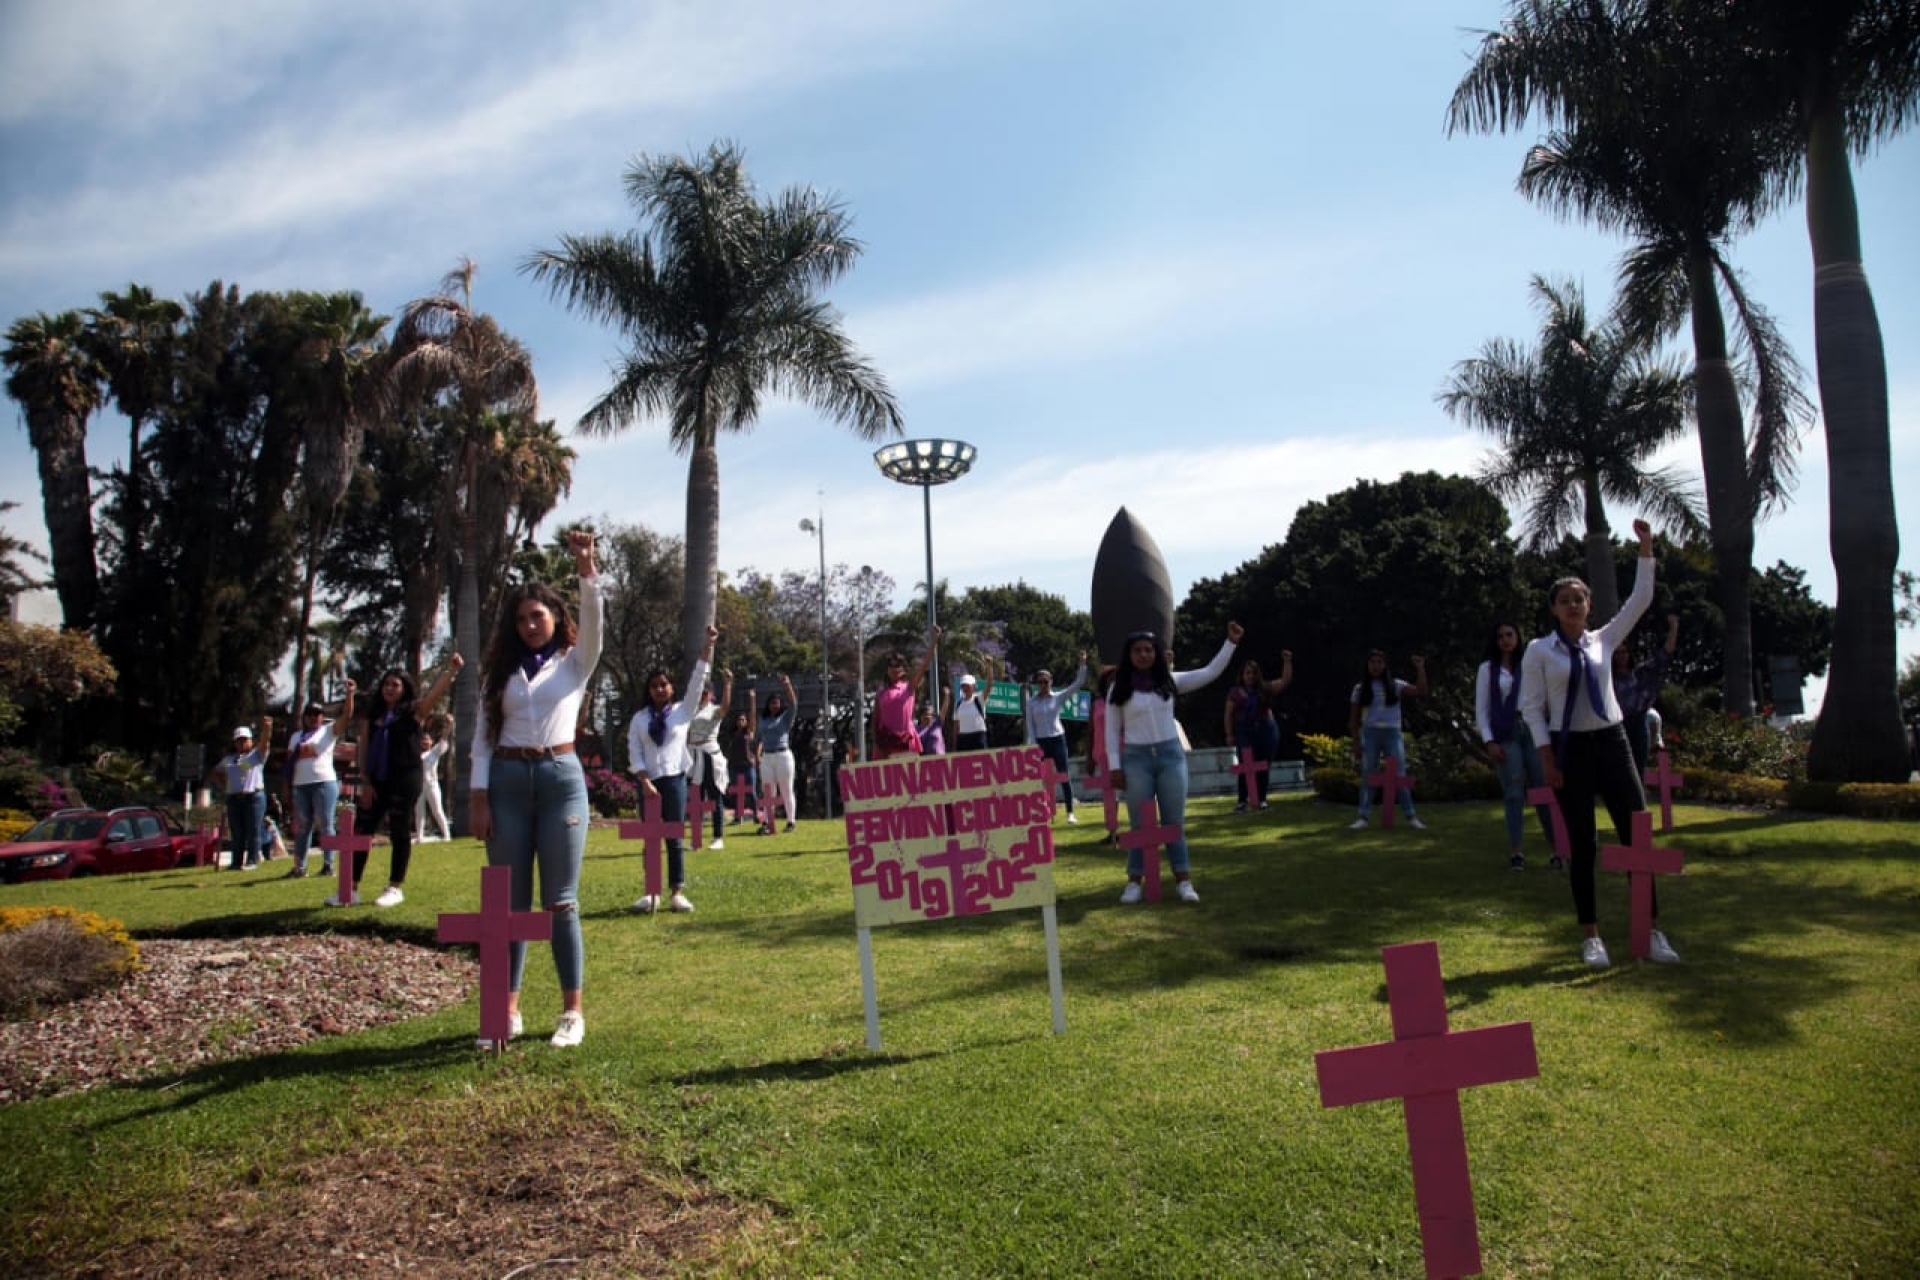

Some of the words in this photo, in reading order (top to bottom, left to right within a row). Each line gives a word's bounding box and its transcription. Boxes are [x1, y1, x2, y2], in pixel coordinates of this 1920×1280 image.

[845, 791, 1051, 846] FEMINICIDIOS
[848, 844, 950, 918] 2019
[962, 824, 1056, 914] 2020
